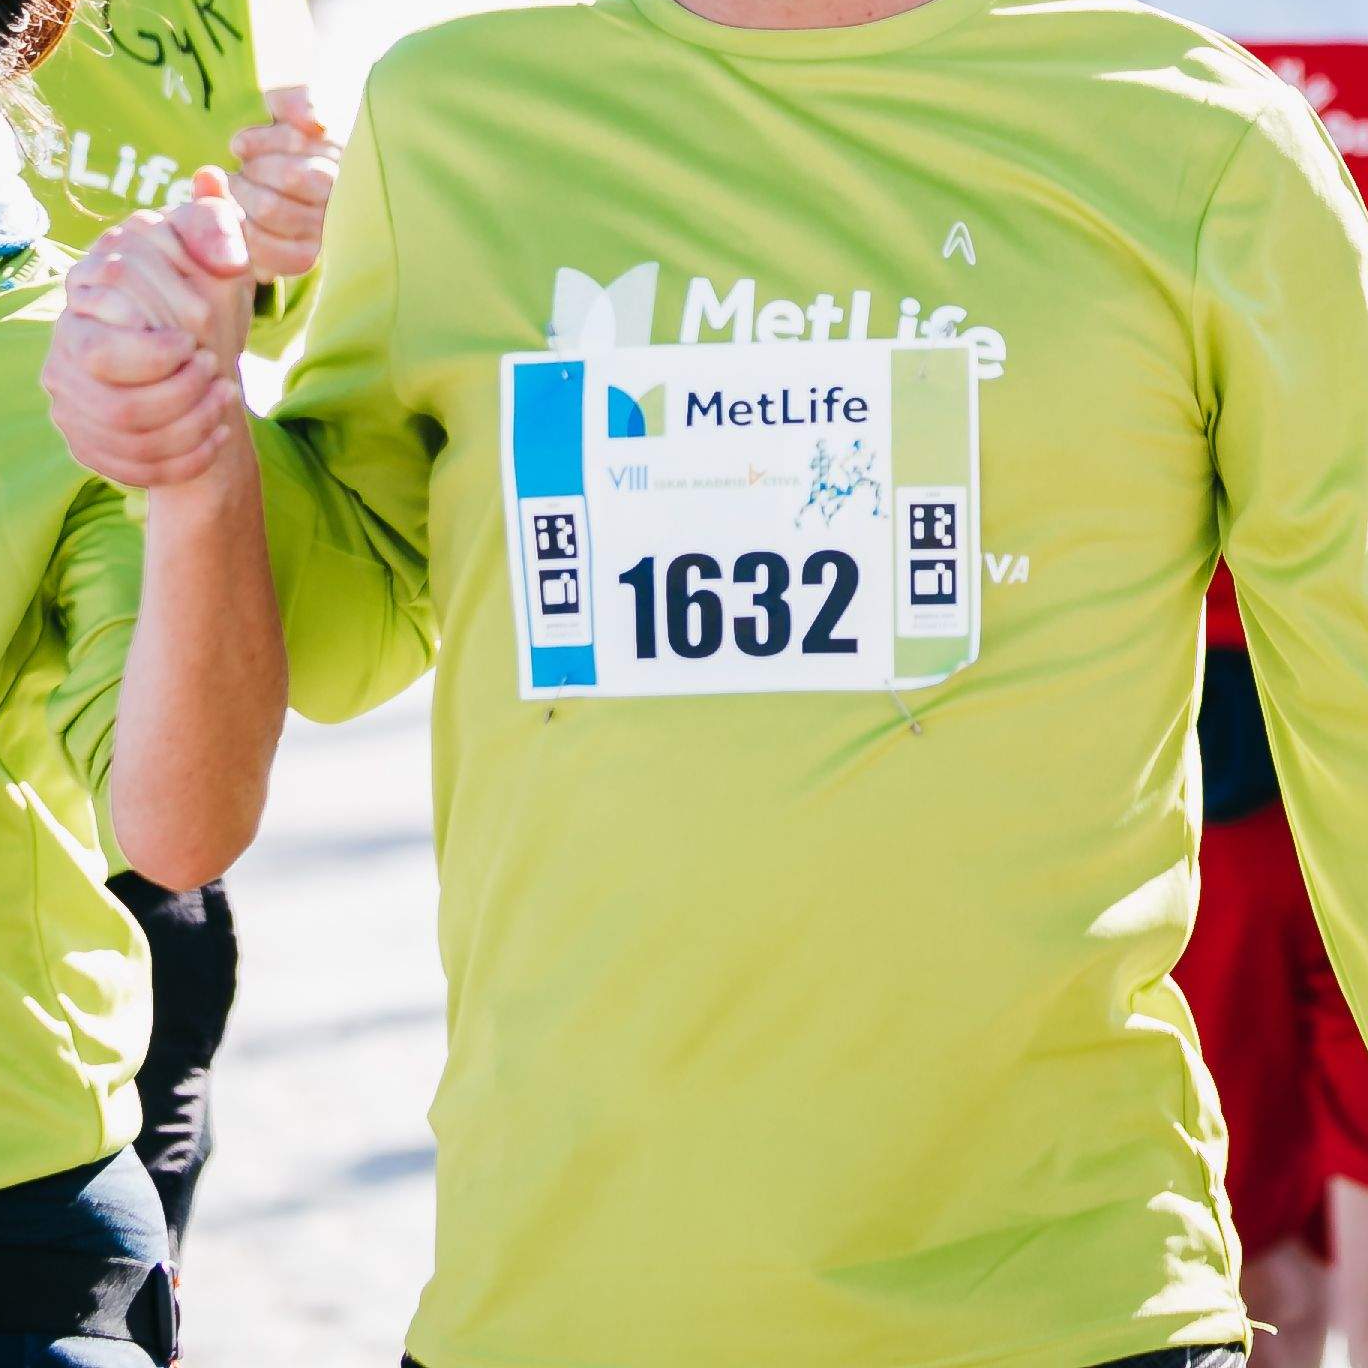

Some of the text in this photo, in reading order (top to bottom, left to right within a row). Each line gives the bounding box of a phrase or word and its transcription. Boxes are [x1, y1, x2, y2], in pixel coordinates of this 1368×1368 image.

[686, 385, 869, 427] MetLife
[608, 464, 649, 490] VIII
[618, 549, 860, 660] 1632
